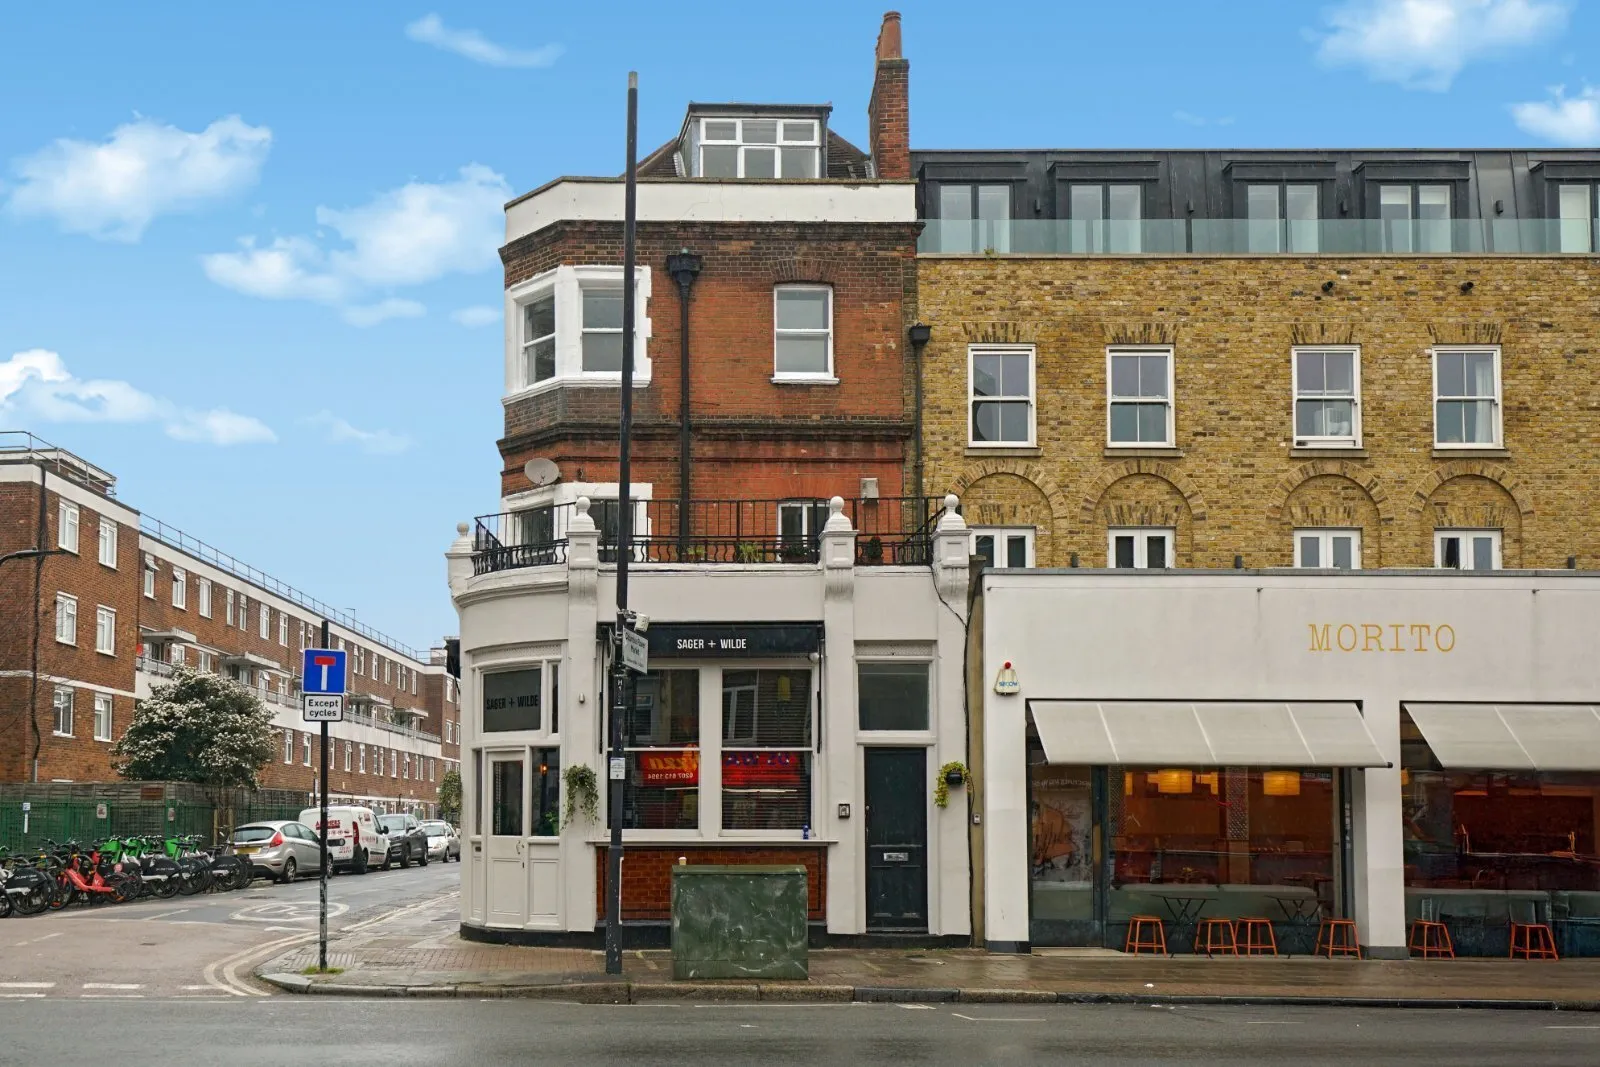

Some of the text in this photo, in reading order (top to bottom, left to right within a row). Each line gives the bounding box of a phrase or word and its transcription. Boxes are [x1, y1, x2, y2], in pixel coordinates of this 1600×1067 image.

[1308, 623, 1456, 652] MORITO
[677, 638, 747, 649] SAGER + WILDE
[308, 699, 339, 708] Except
[517, 694, 539, 708] WILDE
[309, 709, 337, 718] cycles
